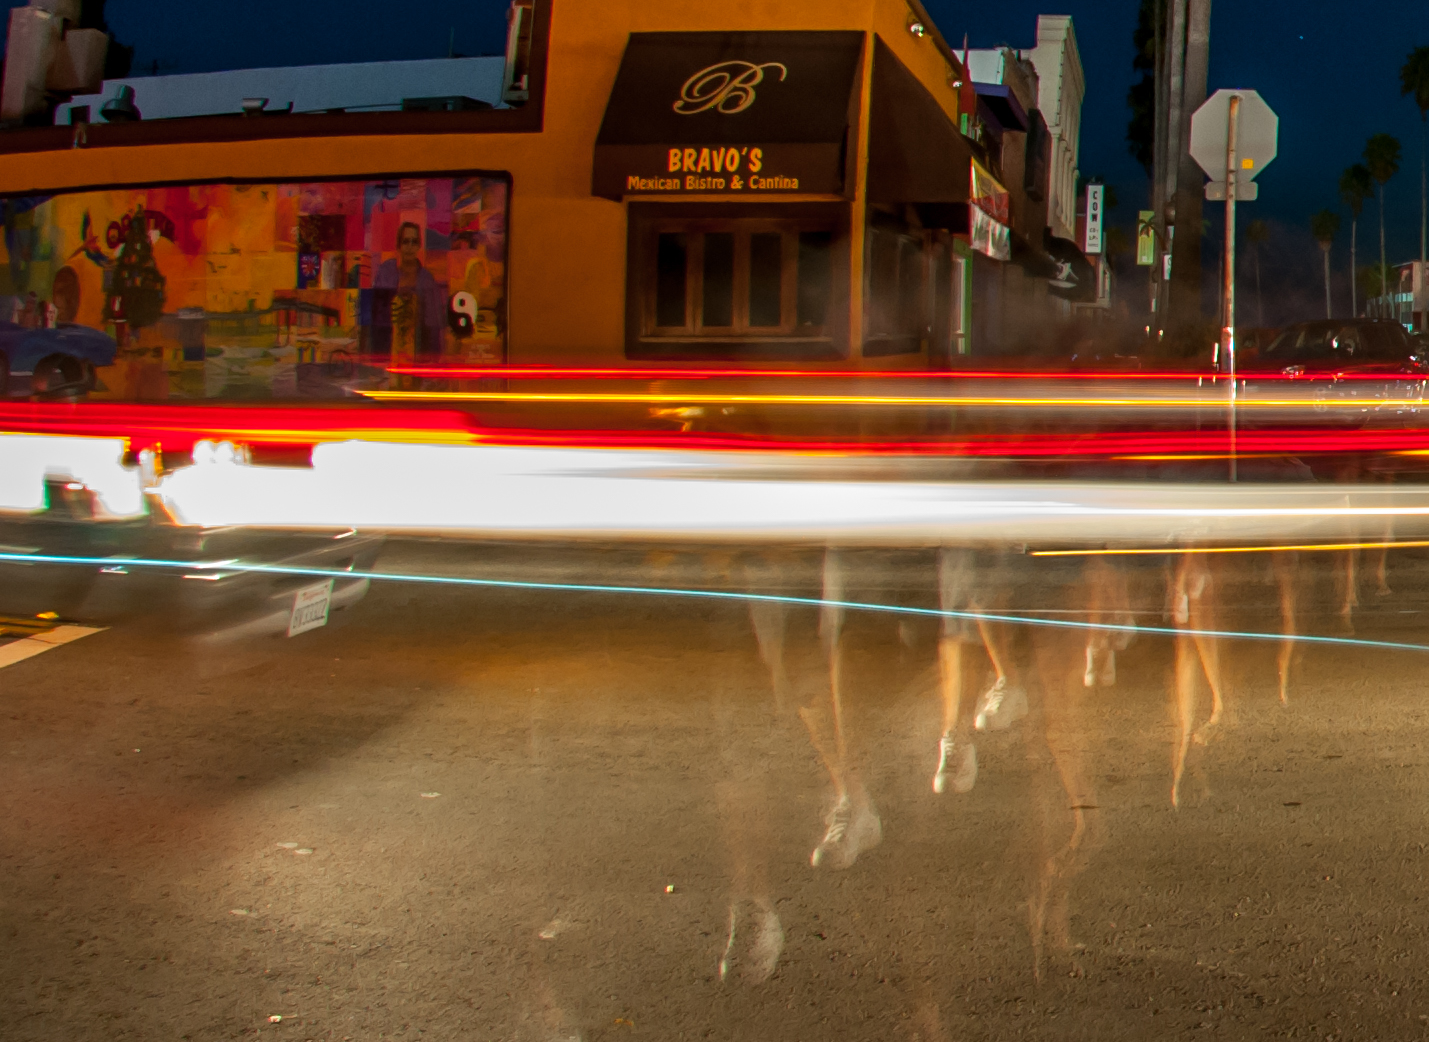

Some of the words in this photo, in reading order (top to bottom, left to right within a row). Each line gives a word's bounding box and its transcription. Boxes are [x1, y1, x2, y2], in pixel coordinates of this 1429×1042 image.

[672, 60, 788, 115] B
[668, 146, 764, 173] BRAVO'S
[626, 175, 681, 191] Mexican
[685, 174, 726, 190] Bistro
[730, 174, 744, 189] &
[749, 174, 799, 190] Cantina
